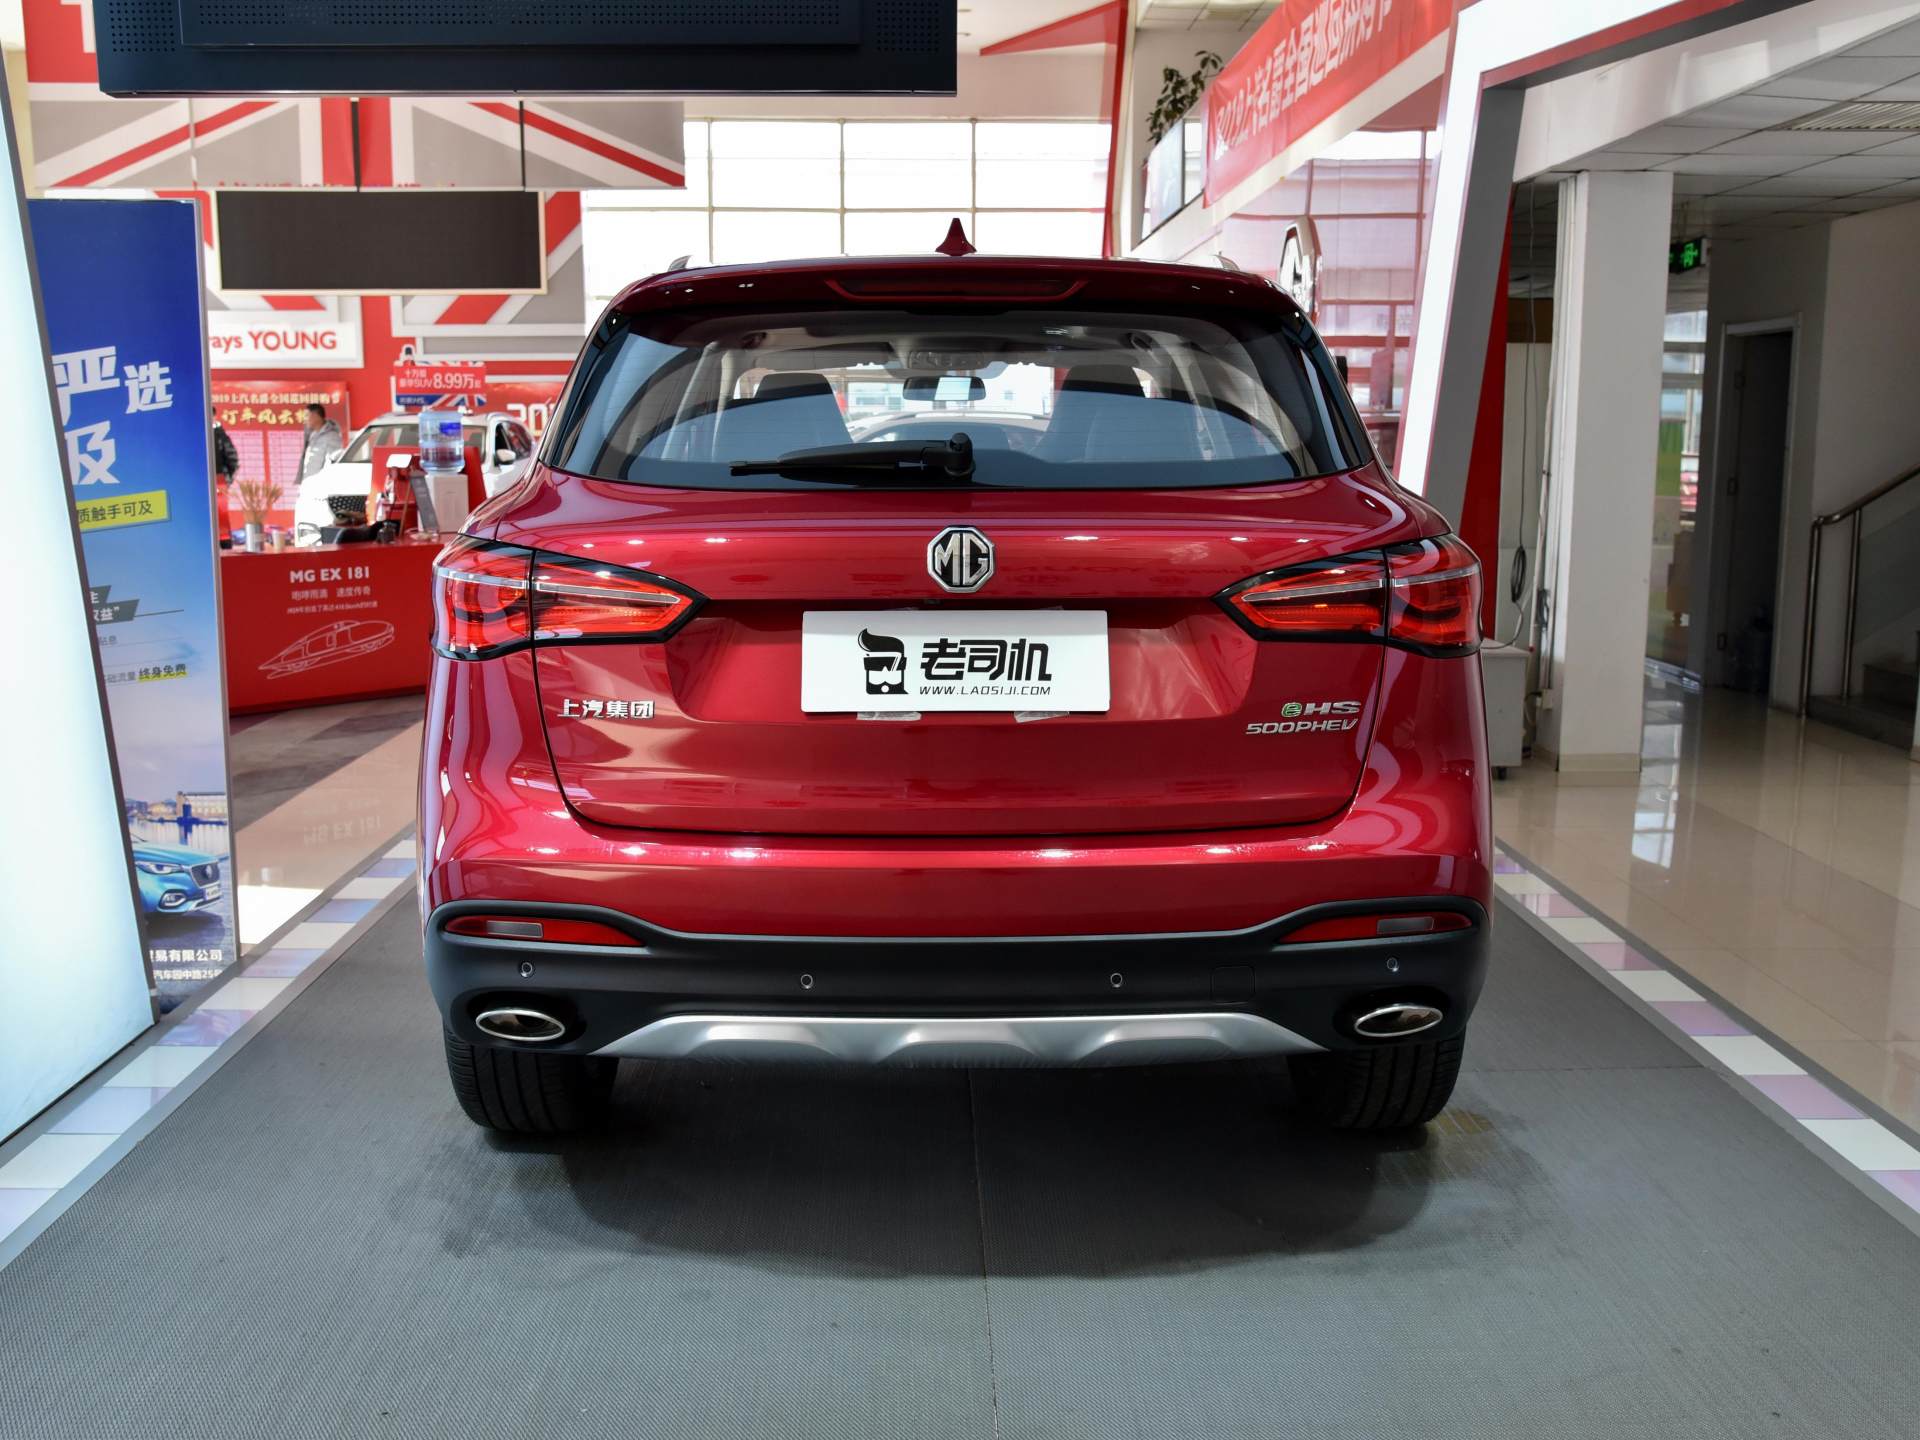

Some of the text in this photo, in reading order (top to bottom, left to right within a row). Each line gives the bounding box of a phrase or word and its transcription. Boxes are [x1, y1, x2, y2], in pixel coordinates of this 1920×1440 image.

[209, 330, 337, 354] ays YOUNG
[933, 531, 990, 588] MG
[289, 566, 370, 584] MG EX 181
[920, 638, 1052, 682] 老司机
[919, 685, 1052, 696] WWW.LAOSIJI.COM
[557, 698, 655, 720] 上汽集团
[1281, 701, 1362, 718] eHS
[1245, 718, 1359, 735] 500PHEV
